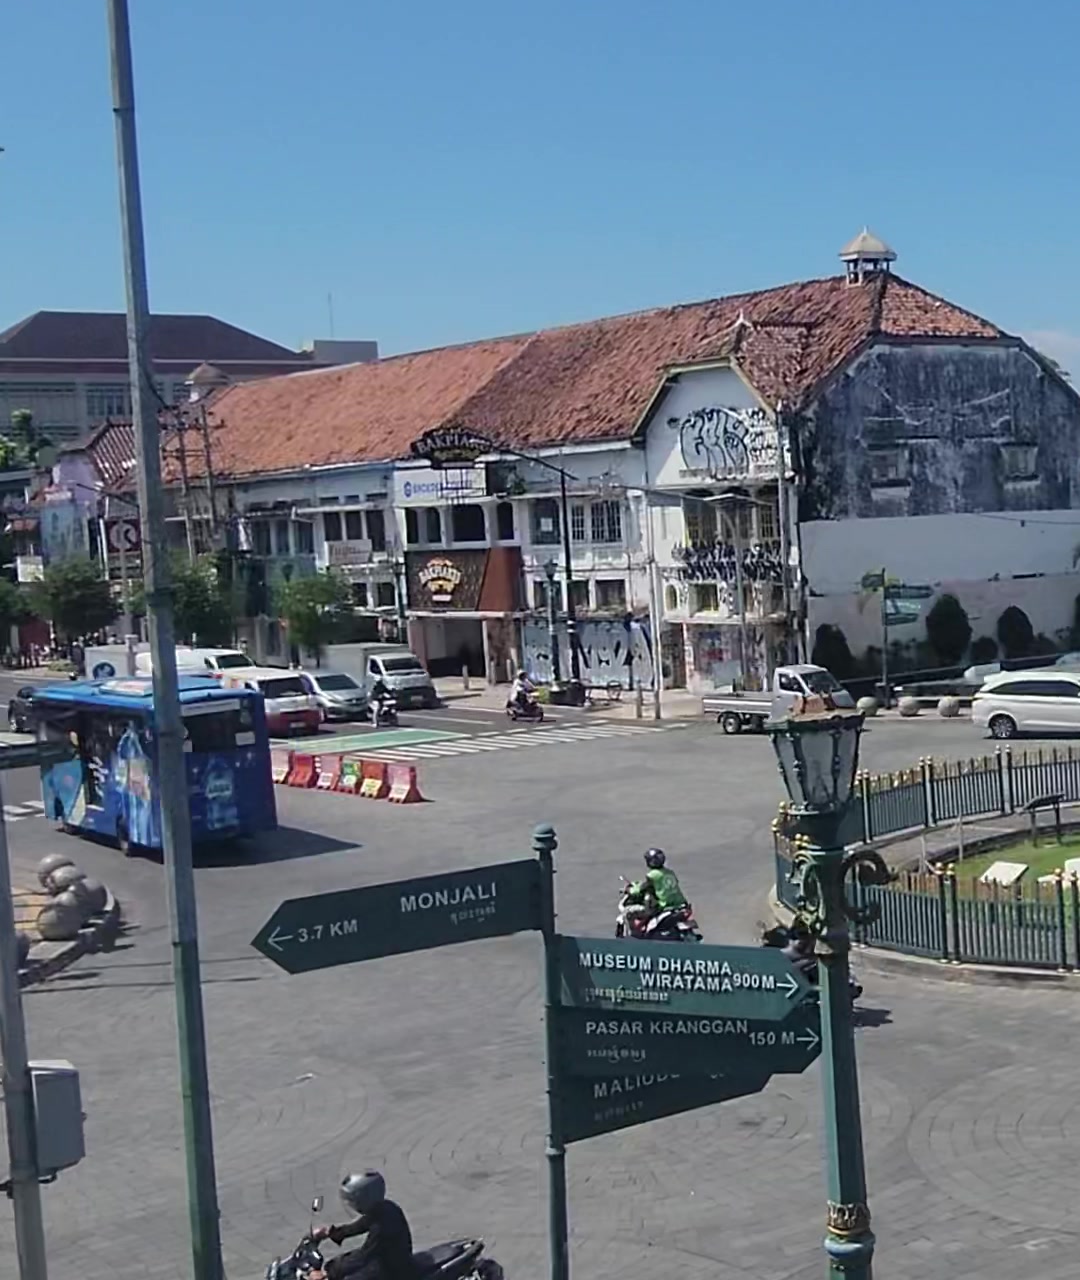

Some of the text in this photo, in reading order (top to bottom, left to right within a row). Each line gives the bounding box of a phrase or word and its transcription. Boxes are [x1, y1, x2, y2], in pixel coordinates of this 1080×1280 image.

[401, 882, 496, 912] MONJALI
[298, 919, 358, 942] 3.7 KM
[579, 952, 733, 975] MUSEUM DHARMA
[640, 972, 733, 991] WIRATAMA
[586, 1020, 748, 1035] PASAR KRANGGAN
[749, 1031, 795, 1045] 150 M
